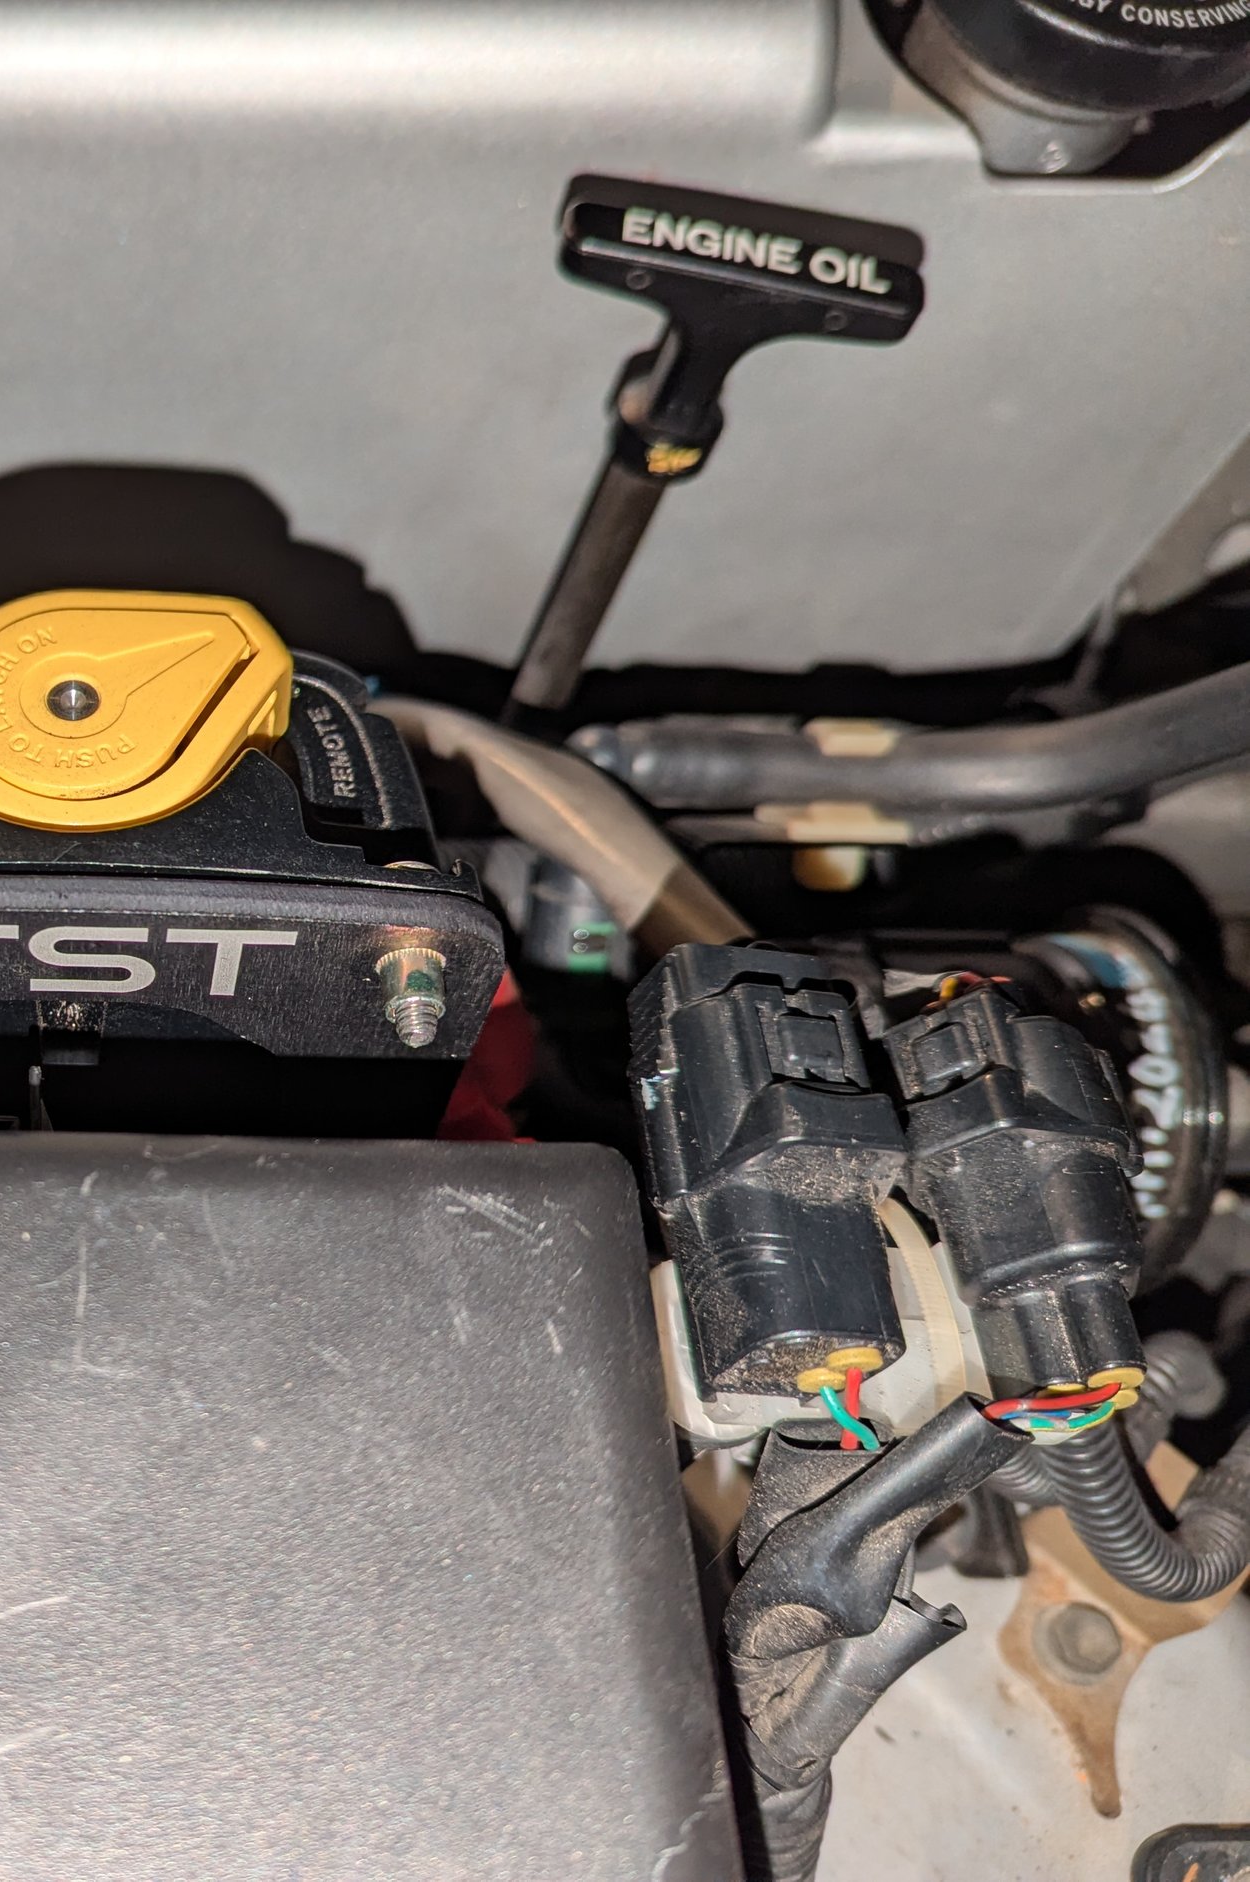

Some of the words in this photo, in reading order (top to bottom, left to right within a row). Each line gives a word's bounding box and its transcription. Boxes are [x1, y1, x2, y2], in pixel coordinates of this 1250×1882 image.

[622, 207, 803, 275] ENGINE
[809, 247, 892, 295] OIL
[17, 626, 58, 655] ON
[7, 733, 44, 764] TO
[53, 733, 138, 768] PUSH
[306, 705, 357, 798] REMOTE
